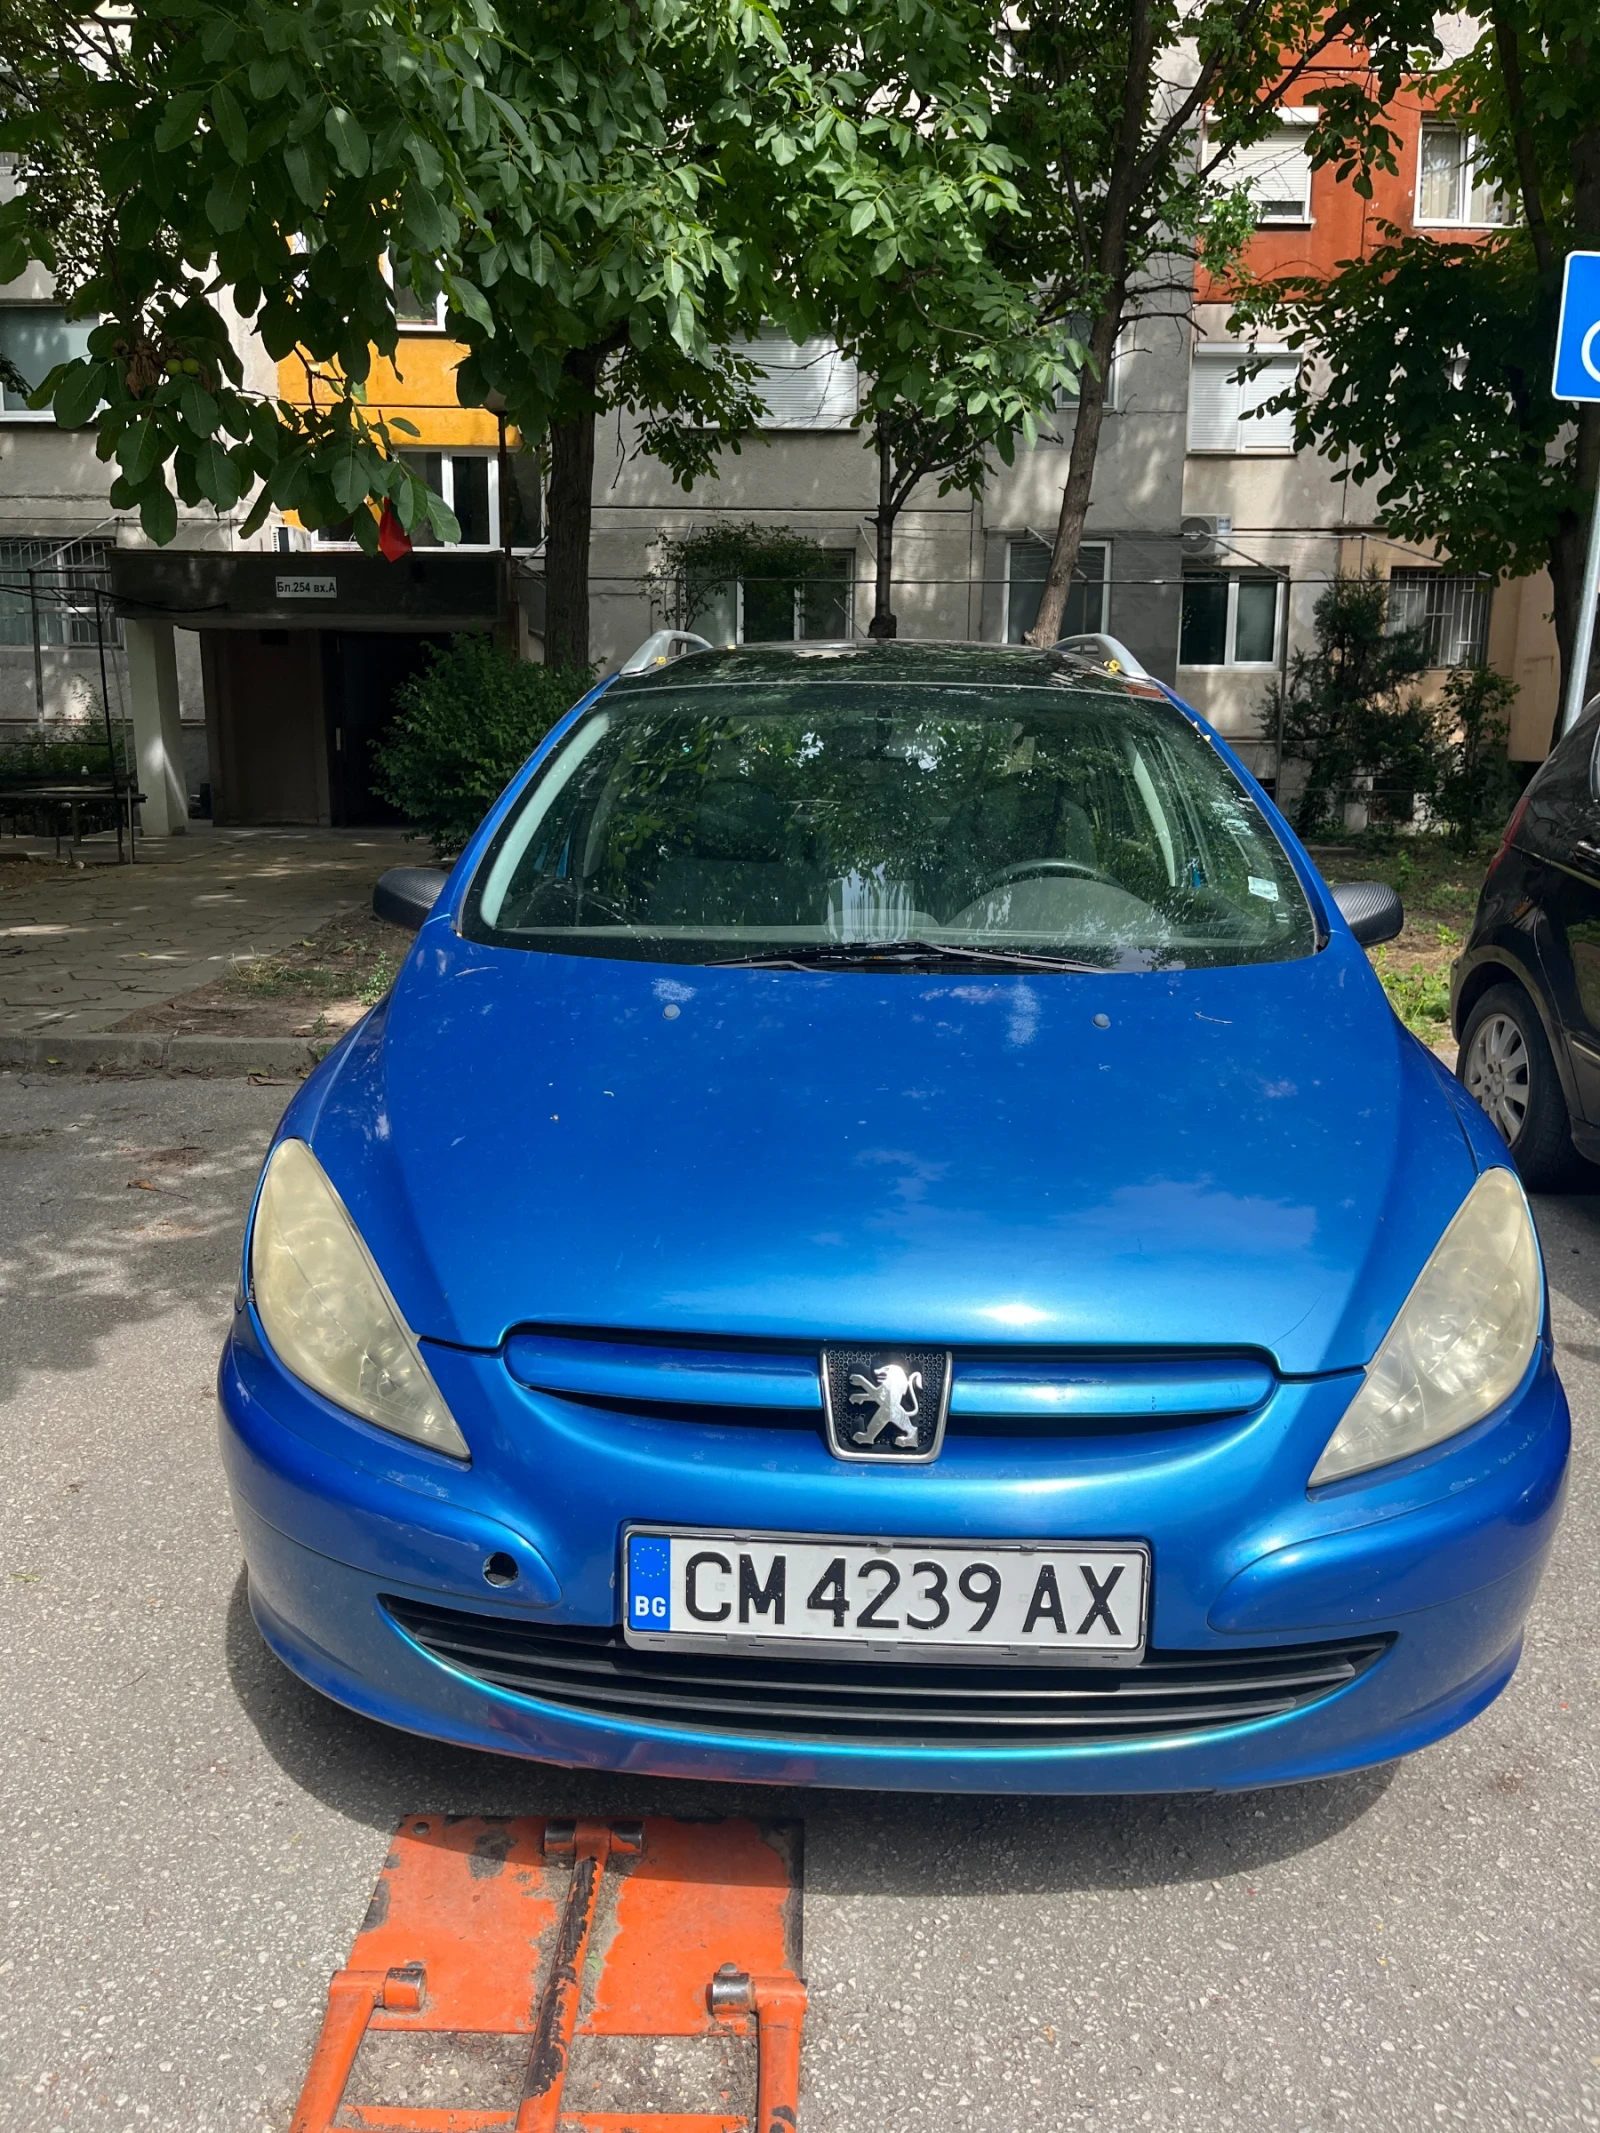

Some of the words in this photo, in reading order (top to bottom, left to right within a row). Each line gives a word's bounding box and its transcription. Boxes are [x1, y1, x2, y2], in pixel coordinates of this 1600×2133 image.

[277, 581, 310, 593] Бл.254
[313, 582, 336, 593] вх.А
[684, 1550, 787, 1626] CM
[806, 1557, 1003, 1633] 4239
[1021, 1563, 1126, 1636] AX
[634, 1596, 667, 1618] BG
